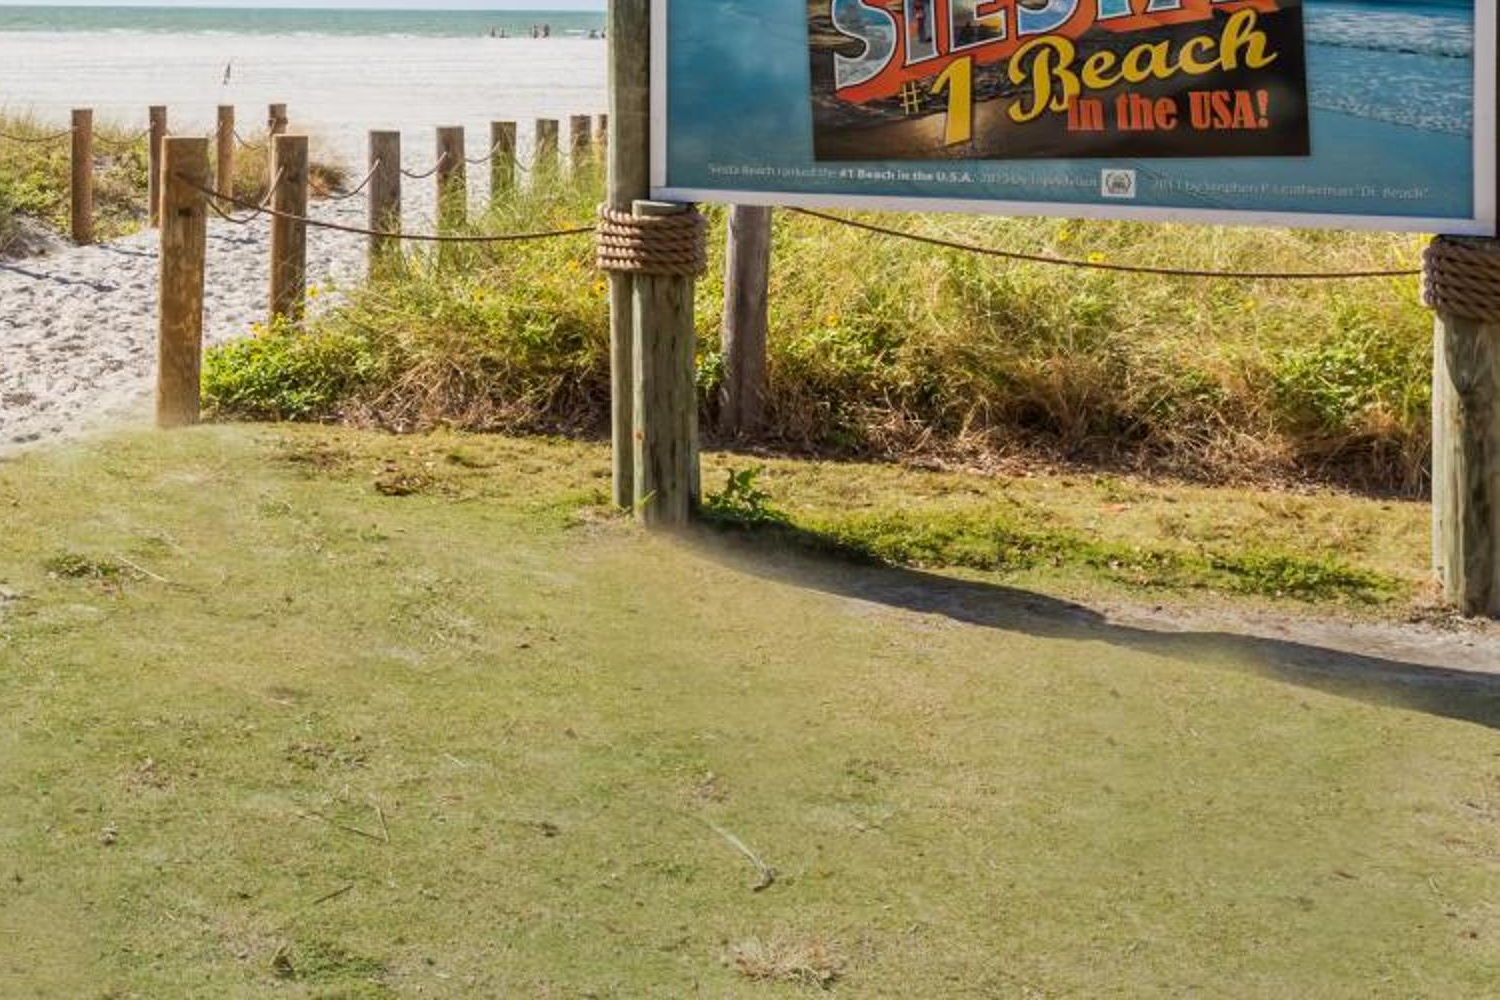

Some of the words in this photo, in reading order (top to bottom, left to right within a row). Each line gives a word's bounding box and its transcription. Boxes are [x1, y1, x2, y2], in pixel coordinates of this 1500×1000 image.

[899, 54, 973, 147] #1
[1007, 7, 1279, 122] Beach
[1067, 94, 1105, 131] in
[1116, 92, 1179, 131] the
[1188, 89, 1269, 129] USA!
[857, 168, 895, 180] Beach
[897, 169, 910, 180] in
[912, 170, 933, 181] the
[935, 171, 974, 183] U.S.A.
